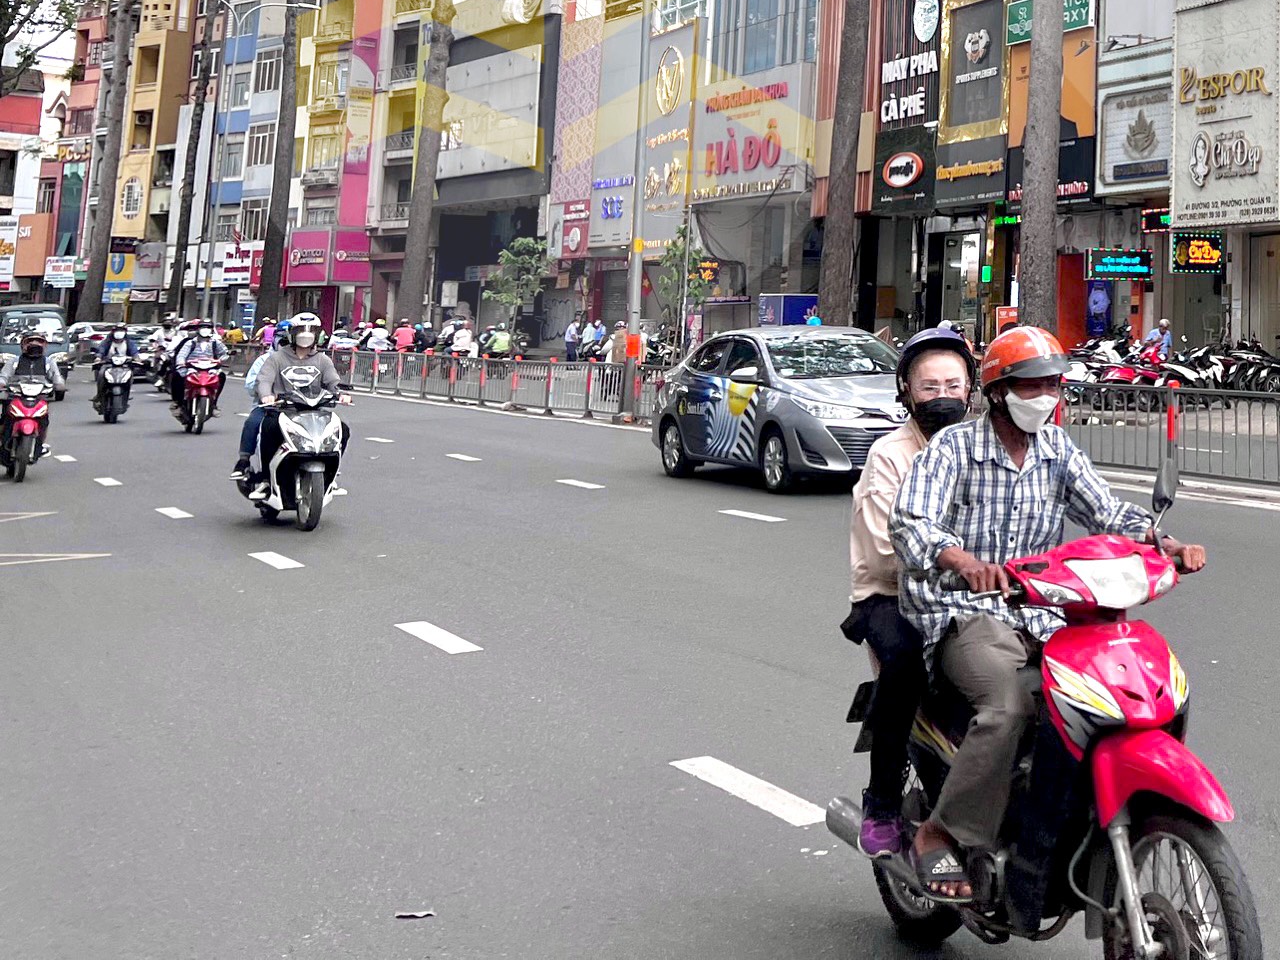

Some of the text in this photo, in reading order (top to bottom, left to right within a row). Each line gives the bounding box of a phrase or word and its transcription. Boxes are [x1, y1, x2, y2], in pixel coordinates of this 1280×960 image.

[1063, 7, 1089, 23] AXY
[882, 51, 938, 84] MÁY PHA
[881, 87, 926, 123] CÀ PHÊ
[706, 118, 782, 177] HÀ ĐÔ
[932, 866, 963, 874] adidas
